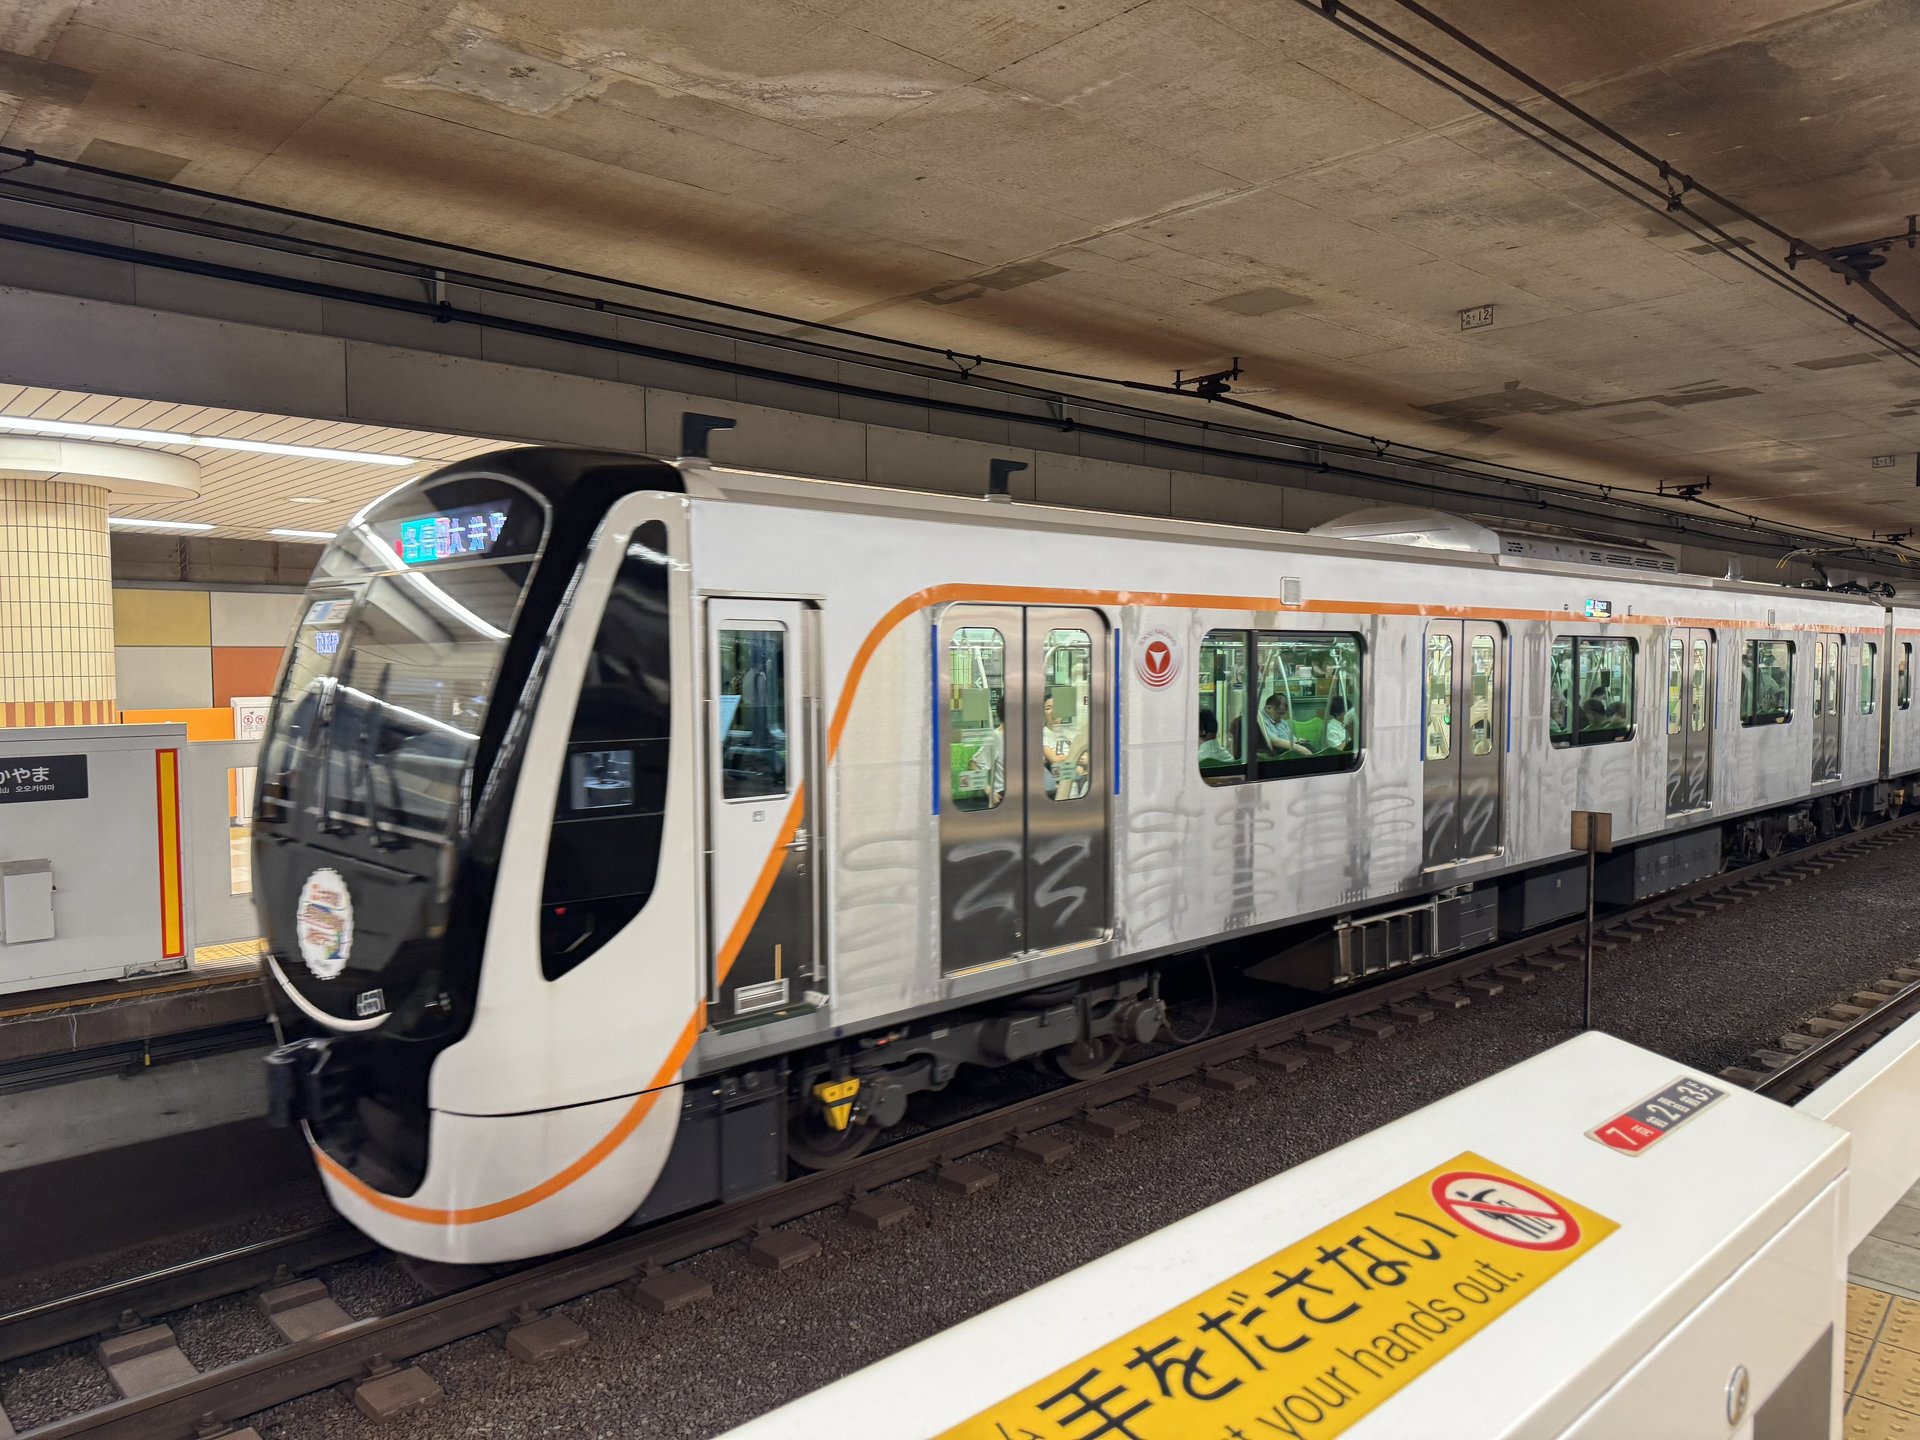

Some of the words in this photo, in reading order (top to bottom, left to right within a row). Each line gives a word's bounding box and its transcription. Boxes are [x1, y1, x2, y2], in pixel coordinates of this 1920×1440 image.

[1036, 1211, 1460, 1440] 手をださない
[1255, 1366, 1361, 1440] your
[1335, 1299, 1466, 1379] hands
[1453, 1258, 1525, 1305] out.
